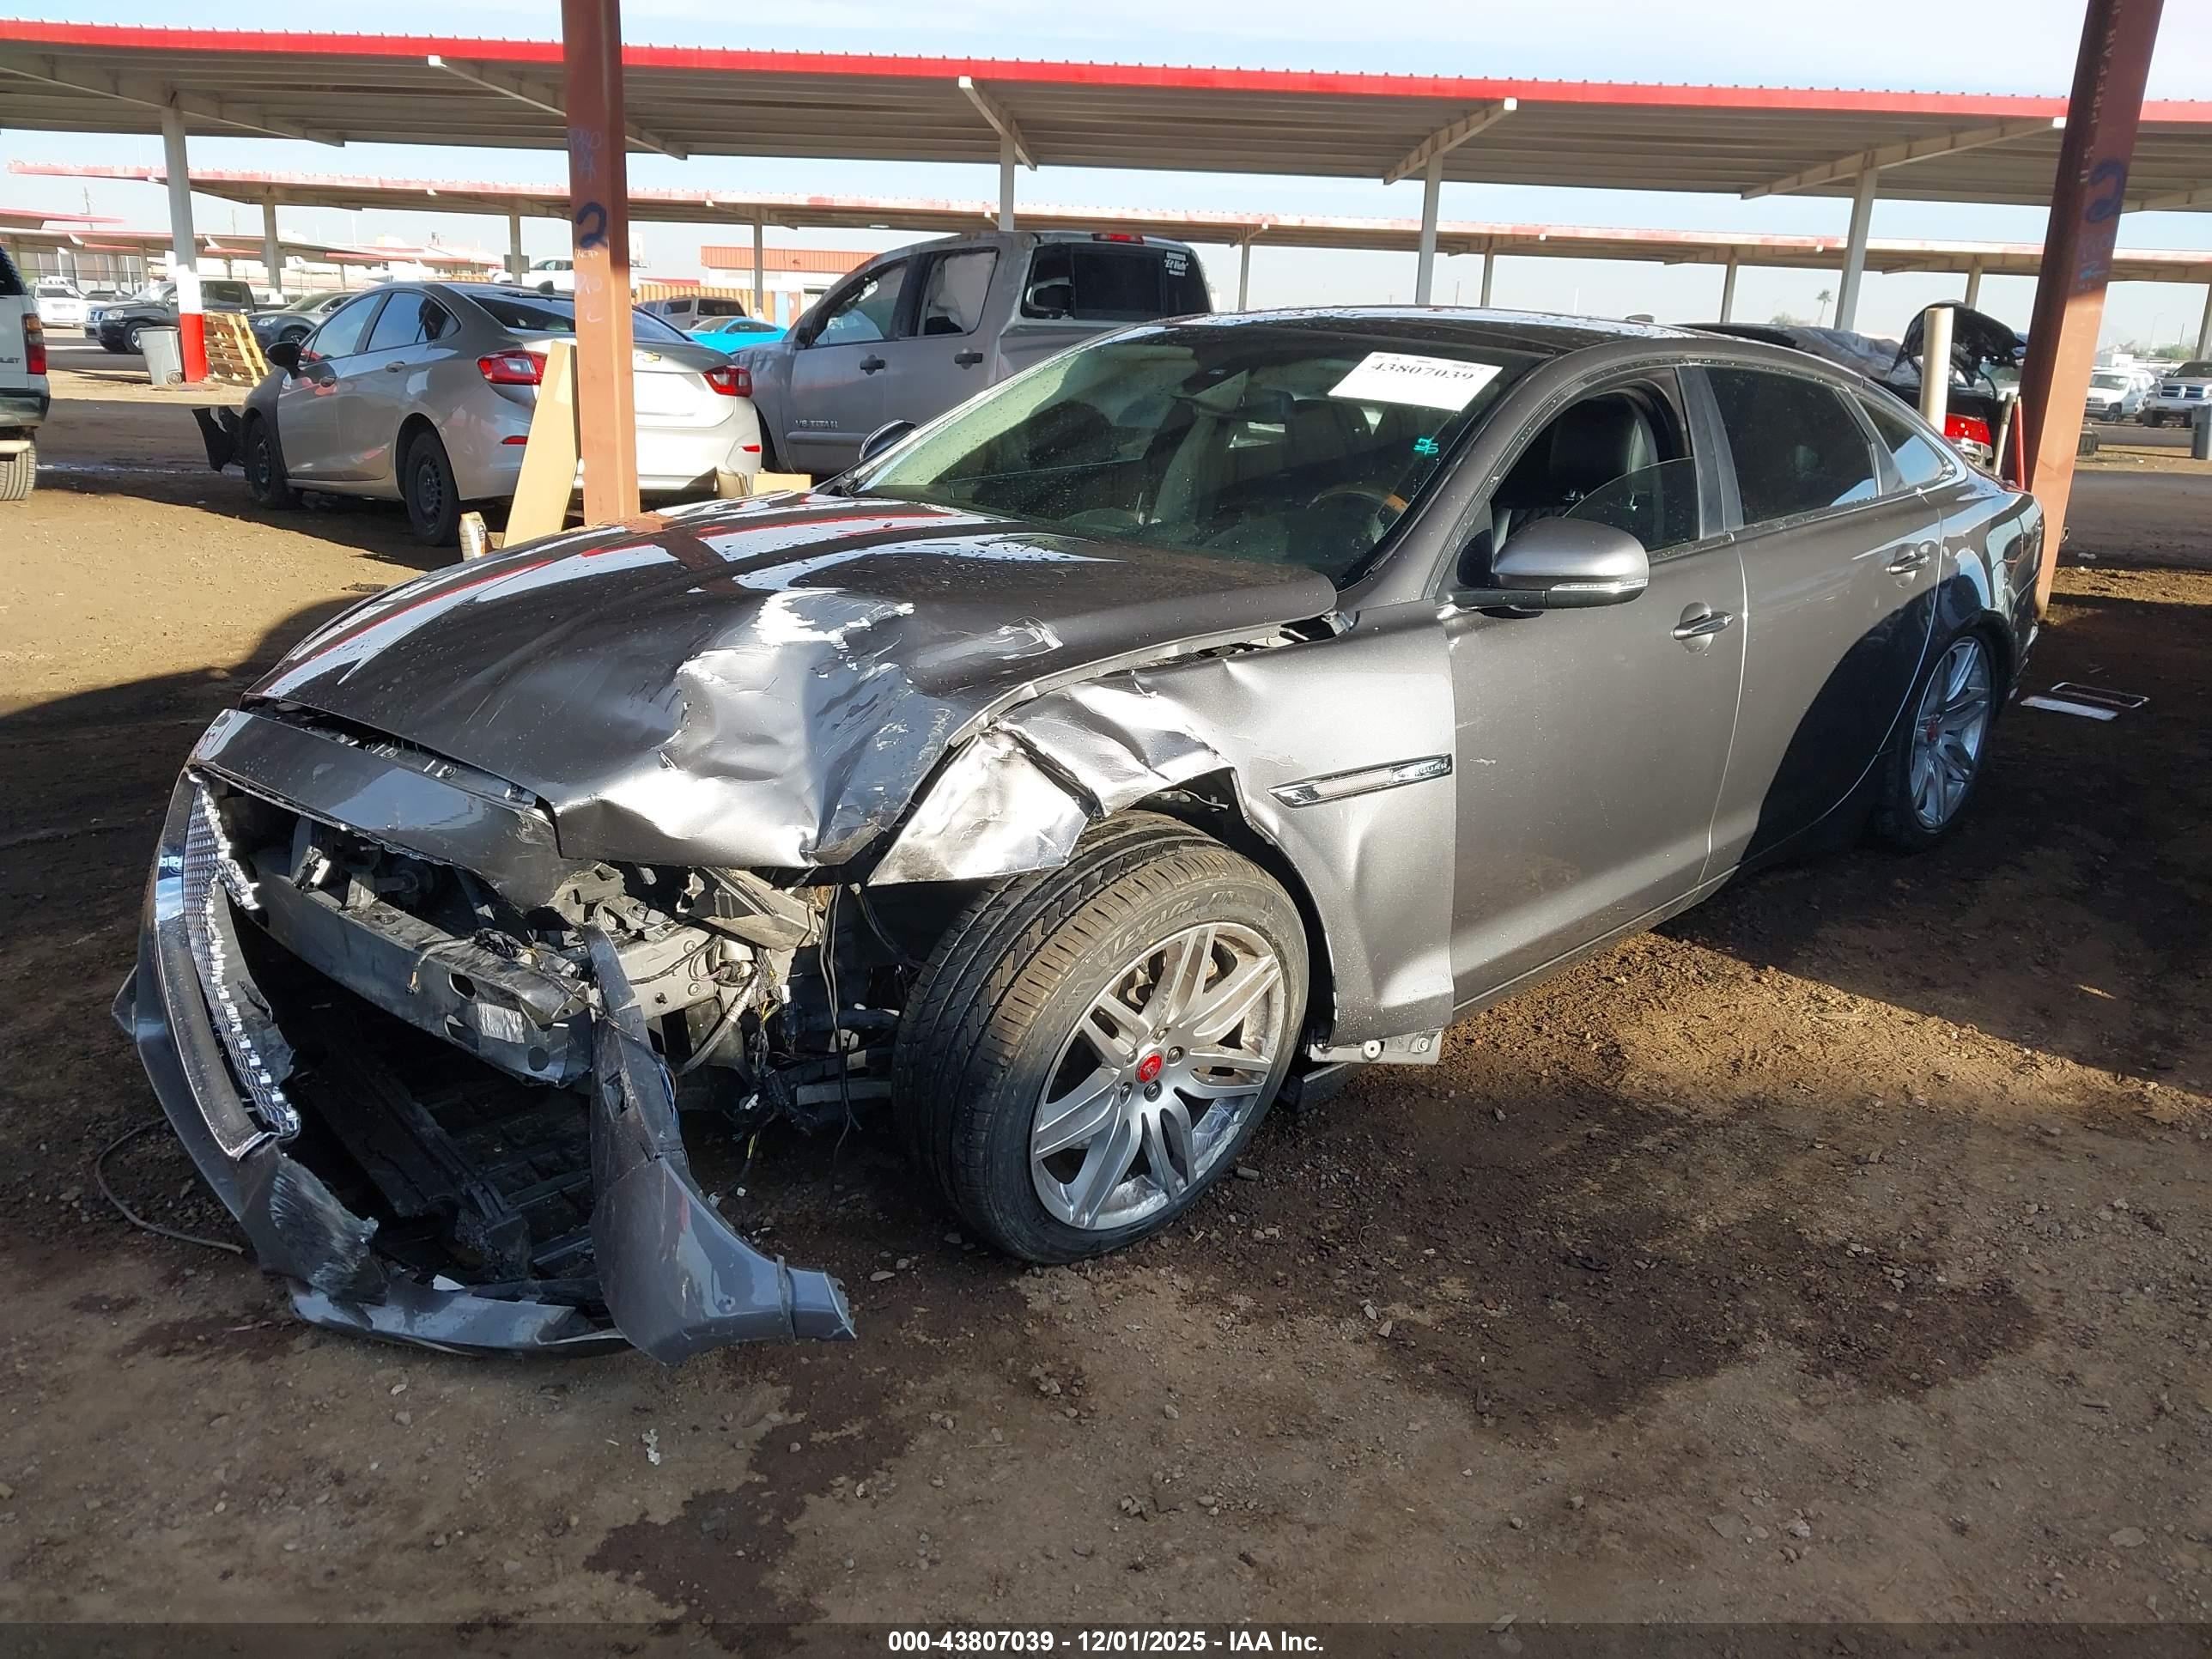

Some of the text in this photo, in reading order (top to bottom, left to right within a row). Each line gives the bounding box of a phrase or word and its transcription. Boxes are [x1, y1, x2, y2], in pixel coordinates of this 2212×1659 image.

[2088, 160, 2125, 223] 2
[575, 201, 607, 249] 2
[1371, 362, 1474, 380] 43807039
[810, 420, 838, 428] TITAN
